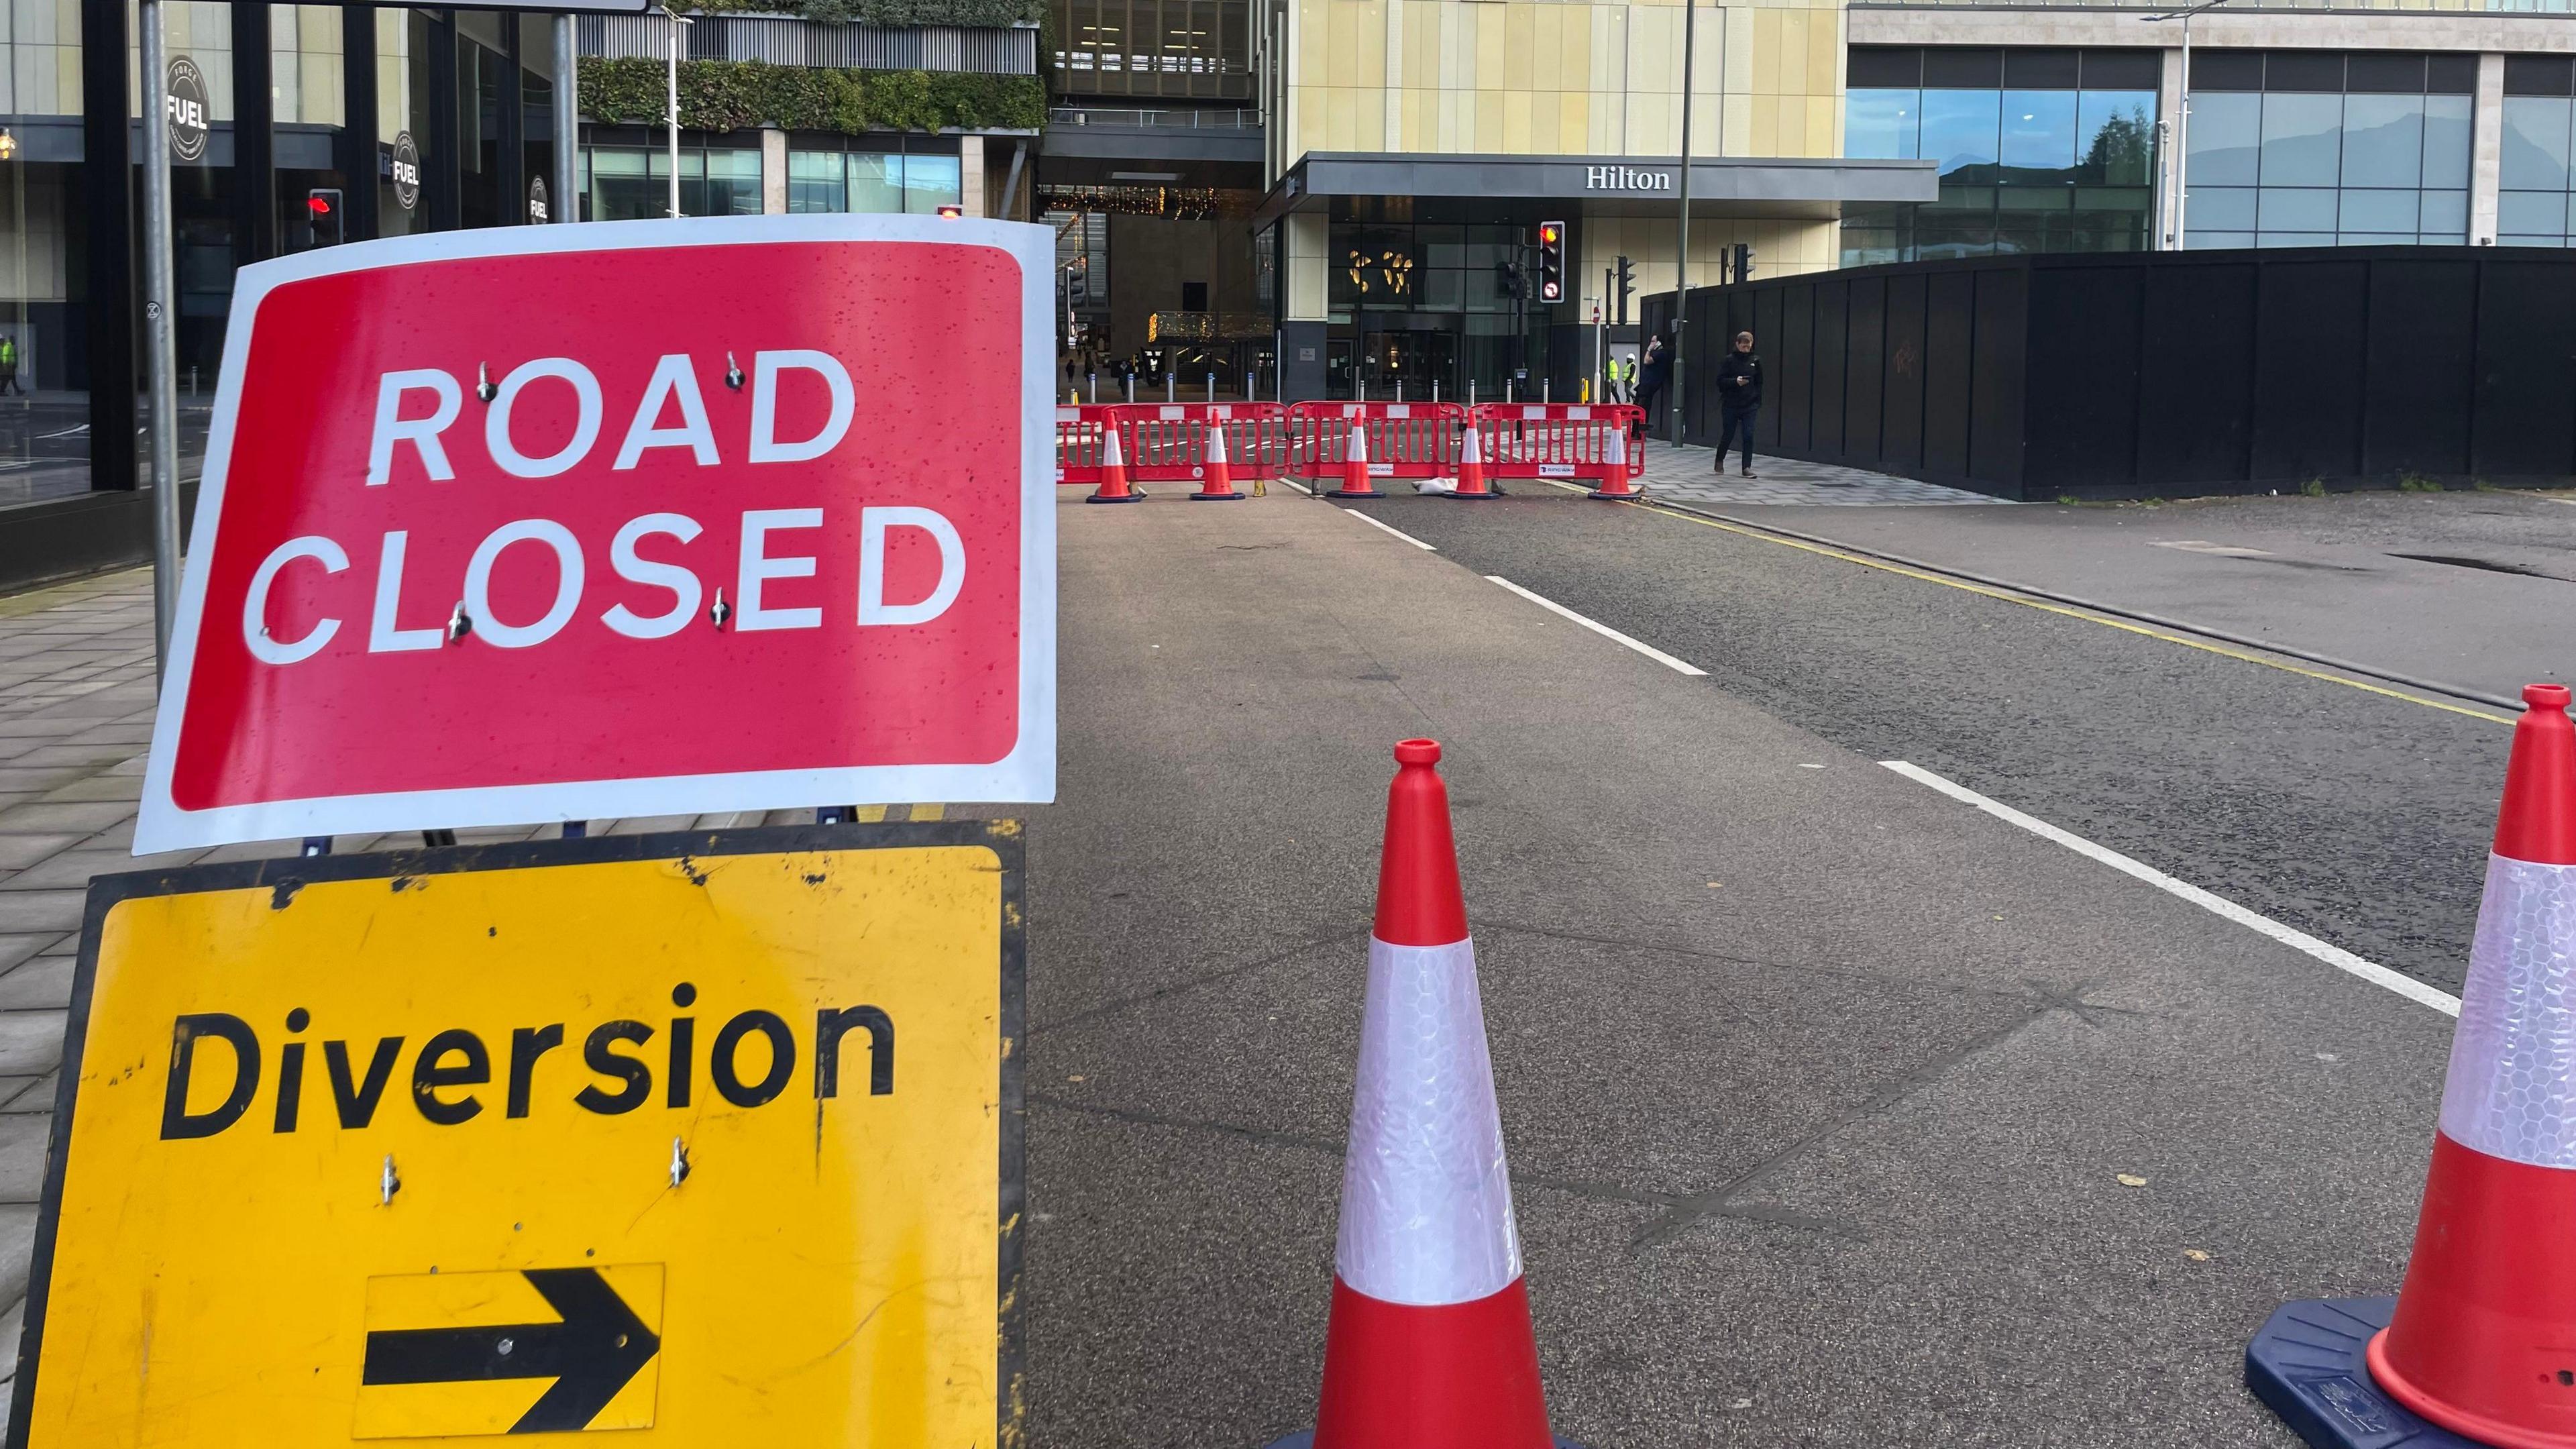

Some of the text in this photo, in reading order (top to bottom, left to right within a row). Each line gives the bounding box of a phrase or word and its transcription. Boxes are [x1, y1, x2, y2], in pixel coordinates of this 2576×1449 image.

[174, 65, 197, 82] FORGE
[168, 95, 207, 130] FUEL
[394, 160, 419, 185] FUEL
[1587, 166, 1670, 190] Hilton
[531, 199, 547, 219] FUEL
[366, 350, 855, 486] ROAD
[244, 506, 966, 665] CLOSED
[160, 982, 896, 1140] Diversion
